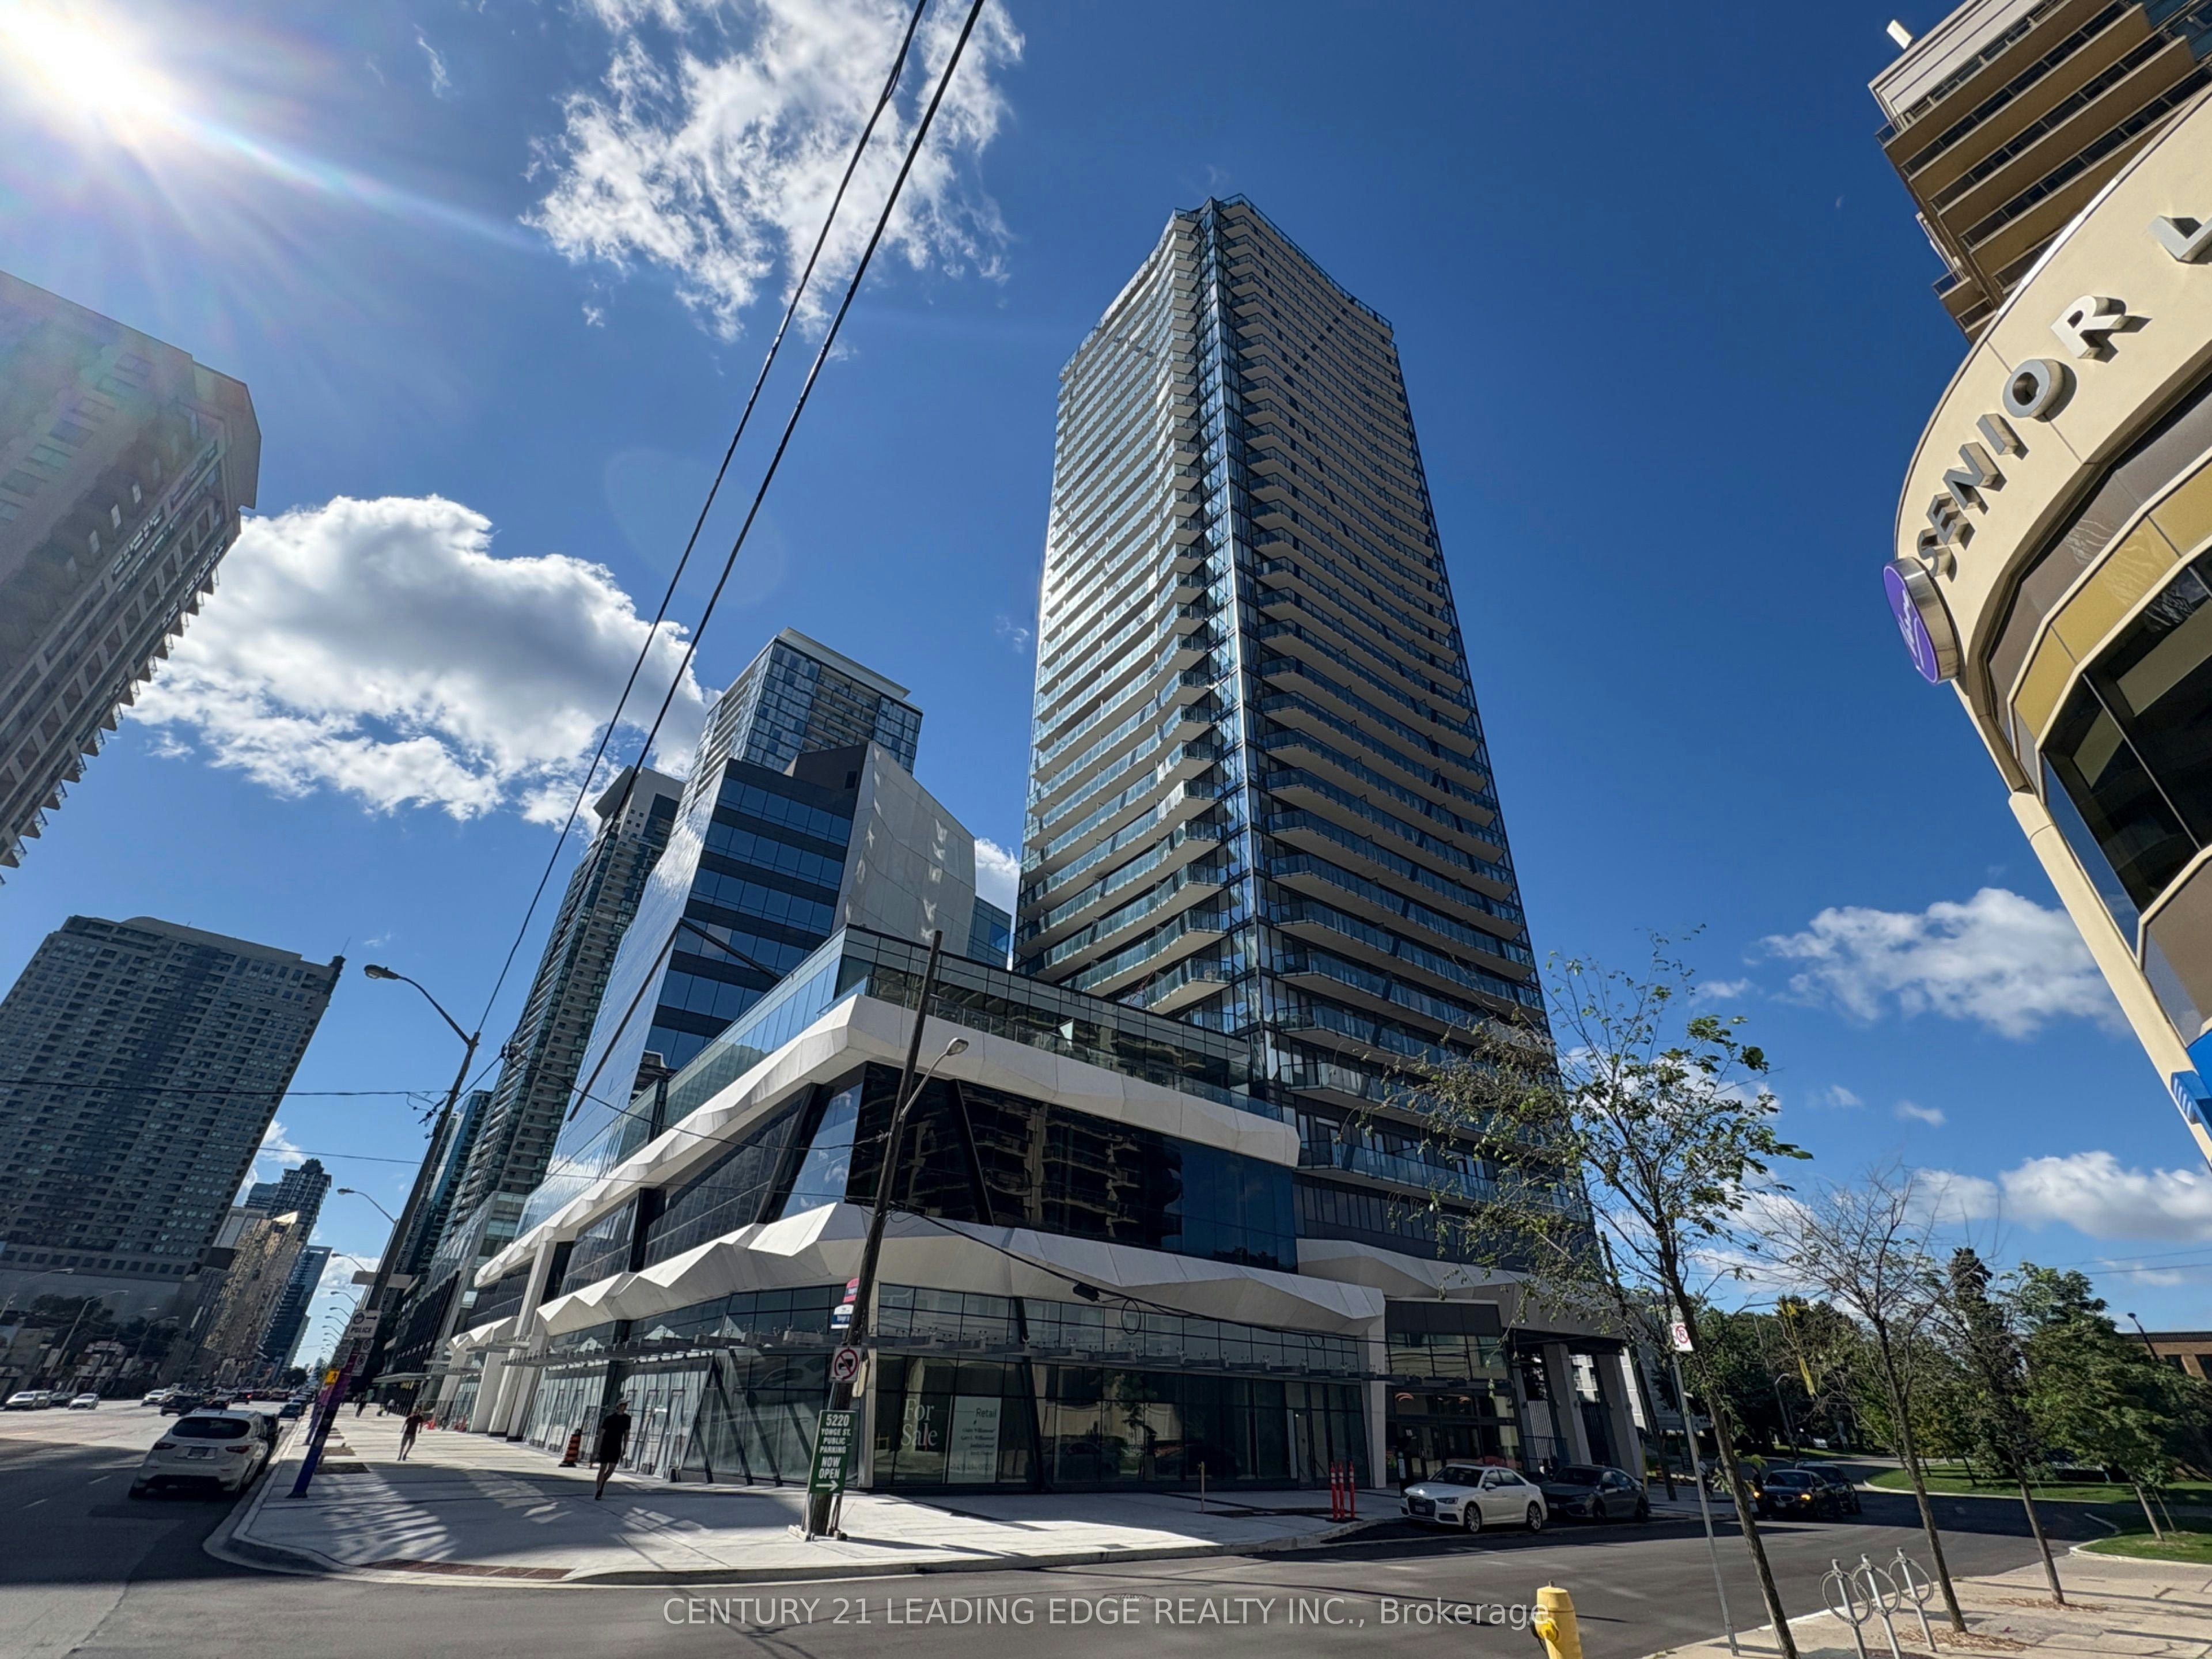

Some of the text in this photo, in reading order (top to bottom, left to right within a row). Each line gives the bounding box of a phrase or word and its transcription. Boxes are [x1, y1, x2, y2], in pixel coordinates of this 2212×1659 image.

[1916, 294, 2130, 577] SENIOR
[903, 1399, 934, 1421] For
[976, 1408, 997, 1418] Retail
[825, 1414, 850, 1427] 5220
[901, 1423, 938, 1446] Sale
[819, 1446, 846, 1454] PARKING
[821, 1456, 841, 1468] NOW
[818, 1468, 840, 1479] OPEN
